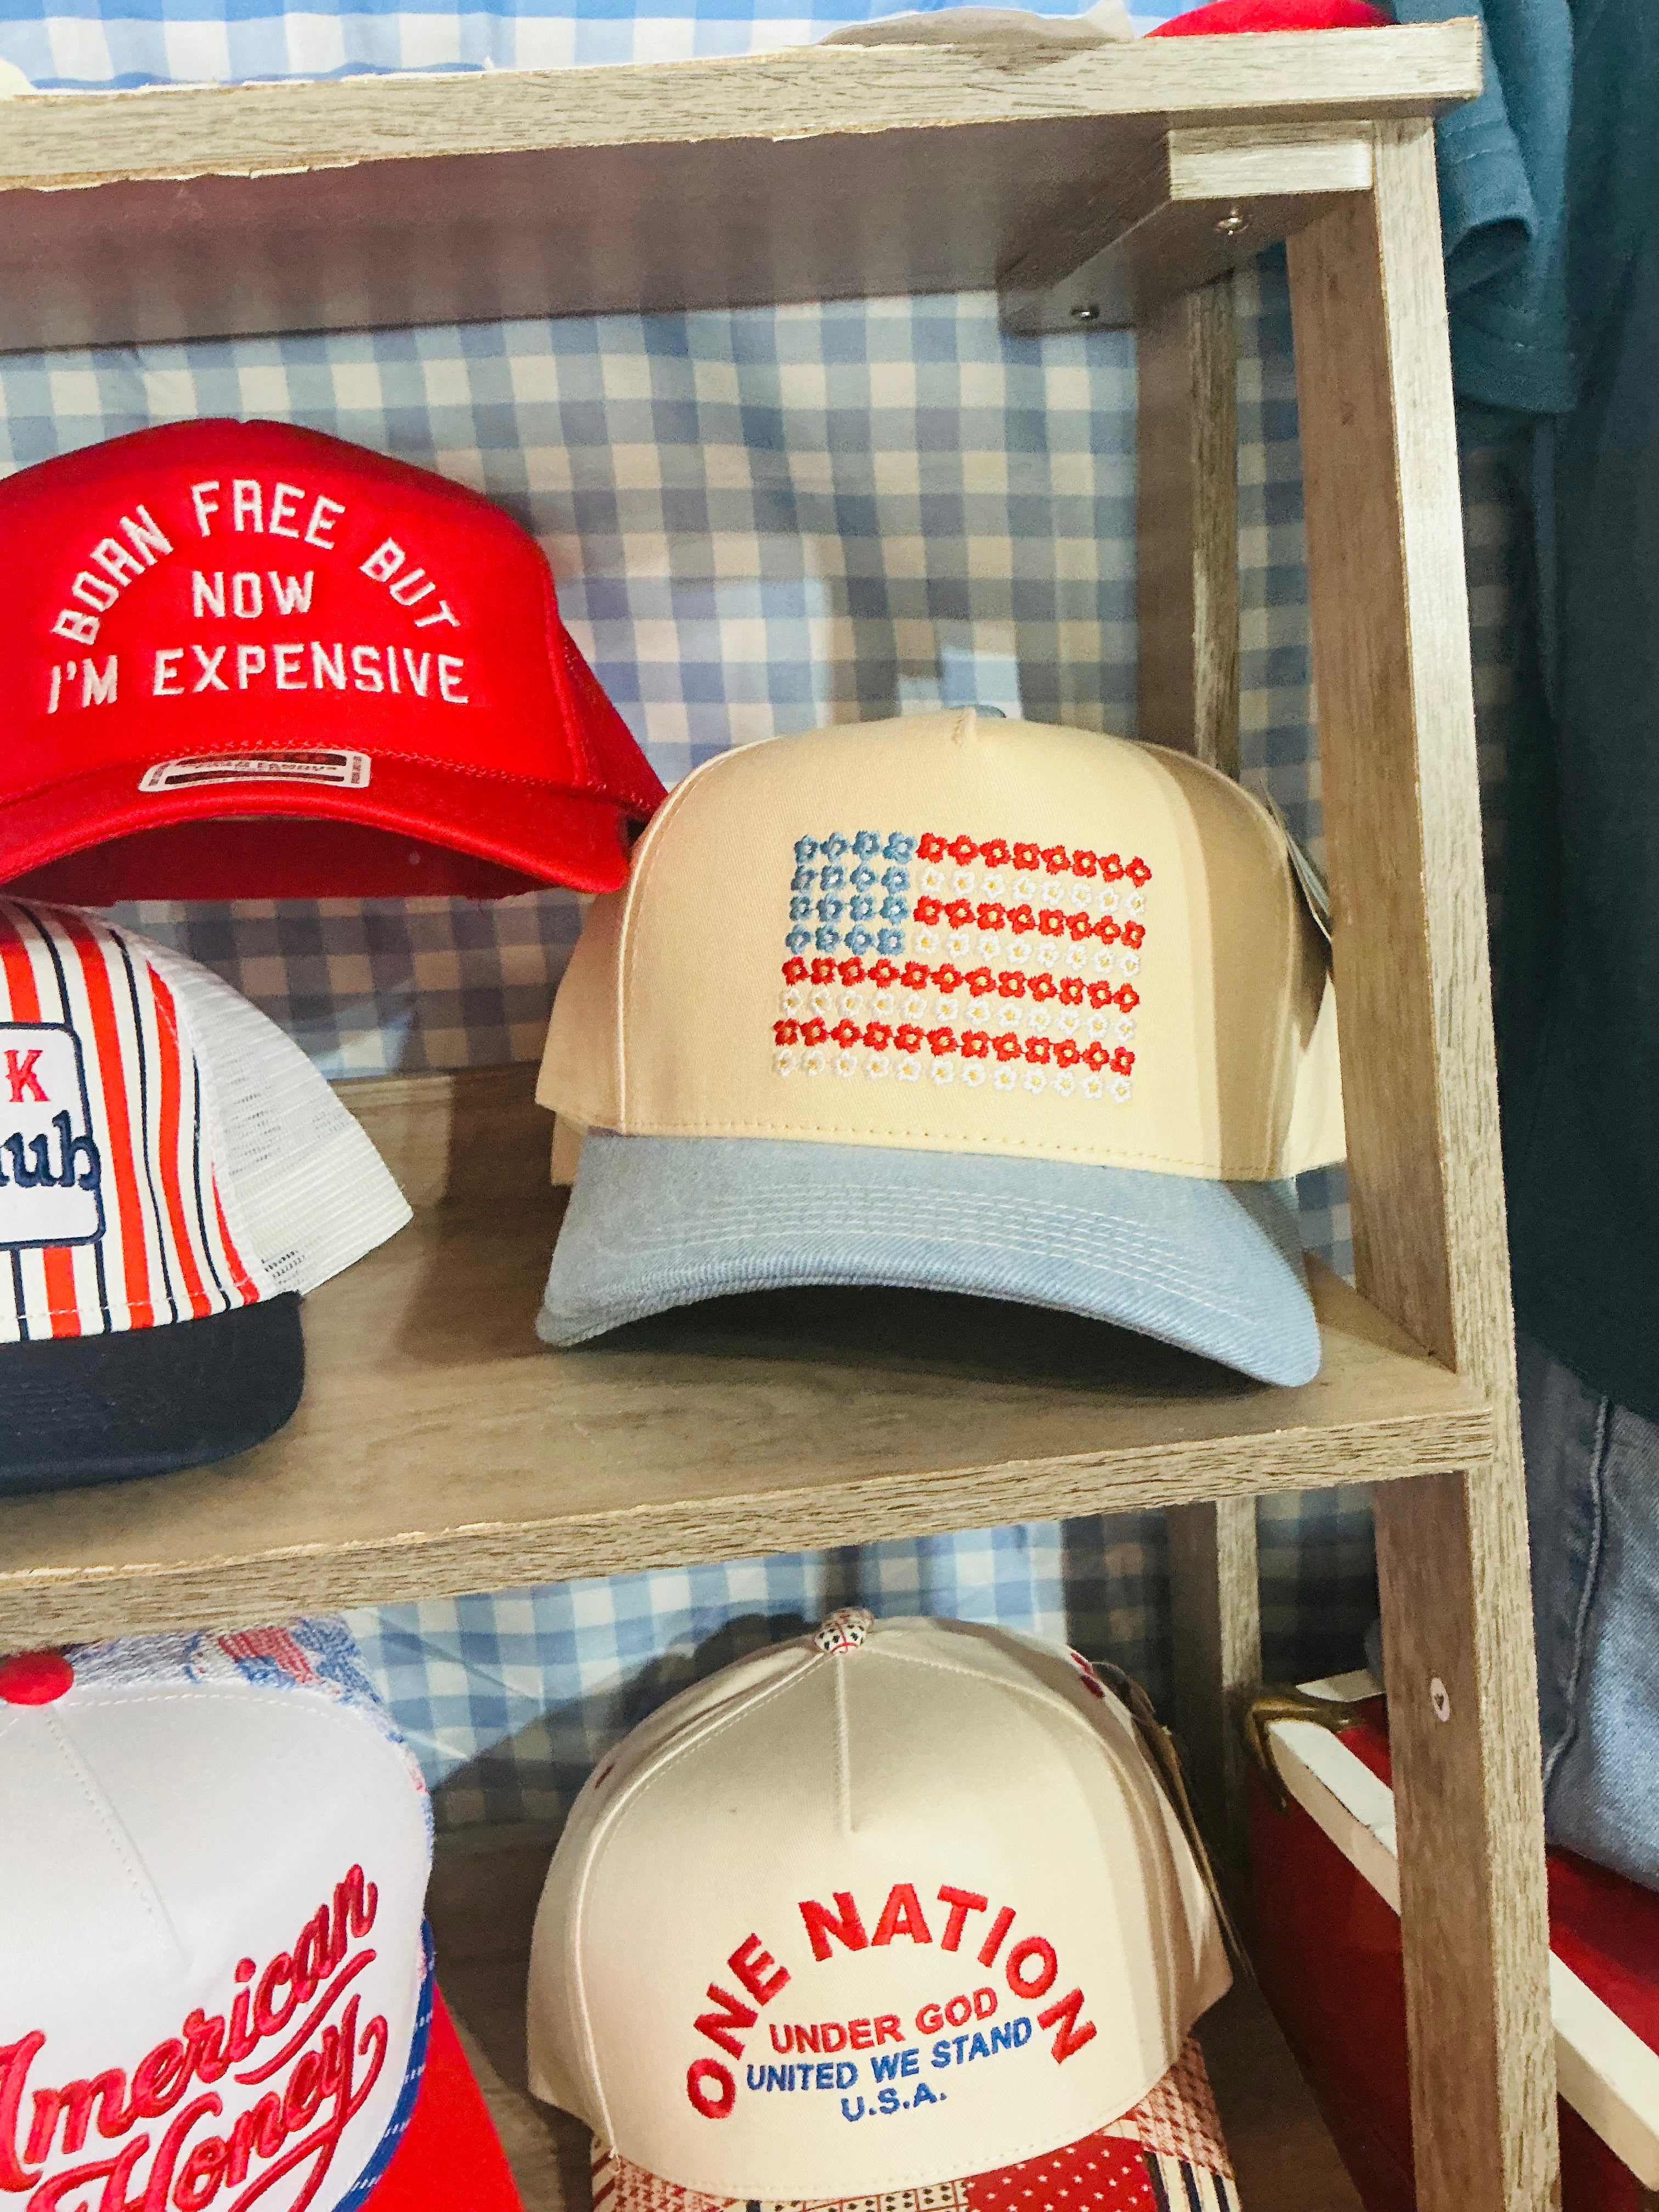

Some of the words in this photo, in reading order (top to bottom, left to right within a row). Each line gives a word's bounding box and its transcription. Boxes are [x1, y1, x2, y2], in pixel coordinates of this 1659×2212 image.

[51, 504, 174, 646] BORN
[191, 478, 346, 550] FREE
[359, 537, 461, 628] BUT
[192, 570, 314, 618] NOW
[47, 655, 118, 714] I'M
[153, 641, 469, 704] EXPENSIVE
[0, 1109, 101, 1192] ub
[686, 1933, 791, 2119] ONE
[798, 1883, 1097, 2065] NATION
[769, 2014, 905, 2055] UNDER
[916, 1987, 998, 2035] GOD
[747, 2061, 859, 2092] UNITED
[870, 2048, 921, 2083] WE
[932, 2017, 1032, 2069] STAND
[25, 1994, 387, 2212] Honey
[841, 2083, 947, 2123] U.S.A.
